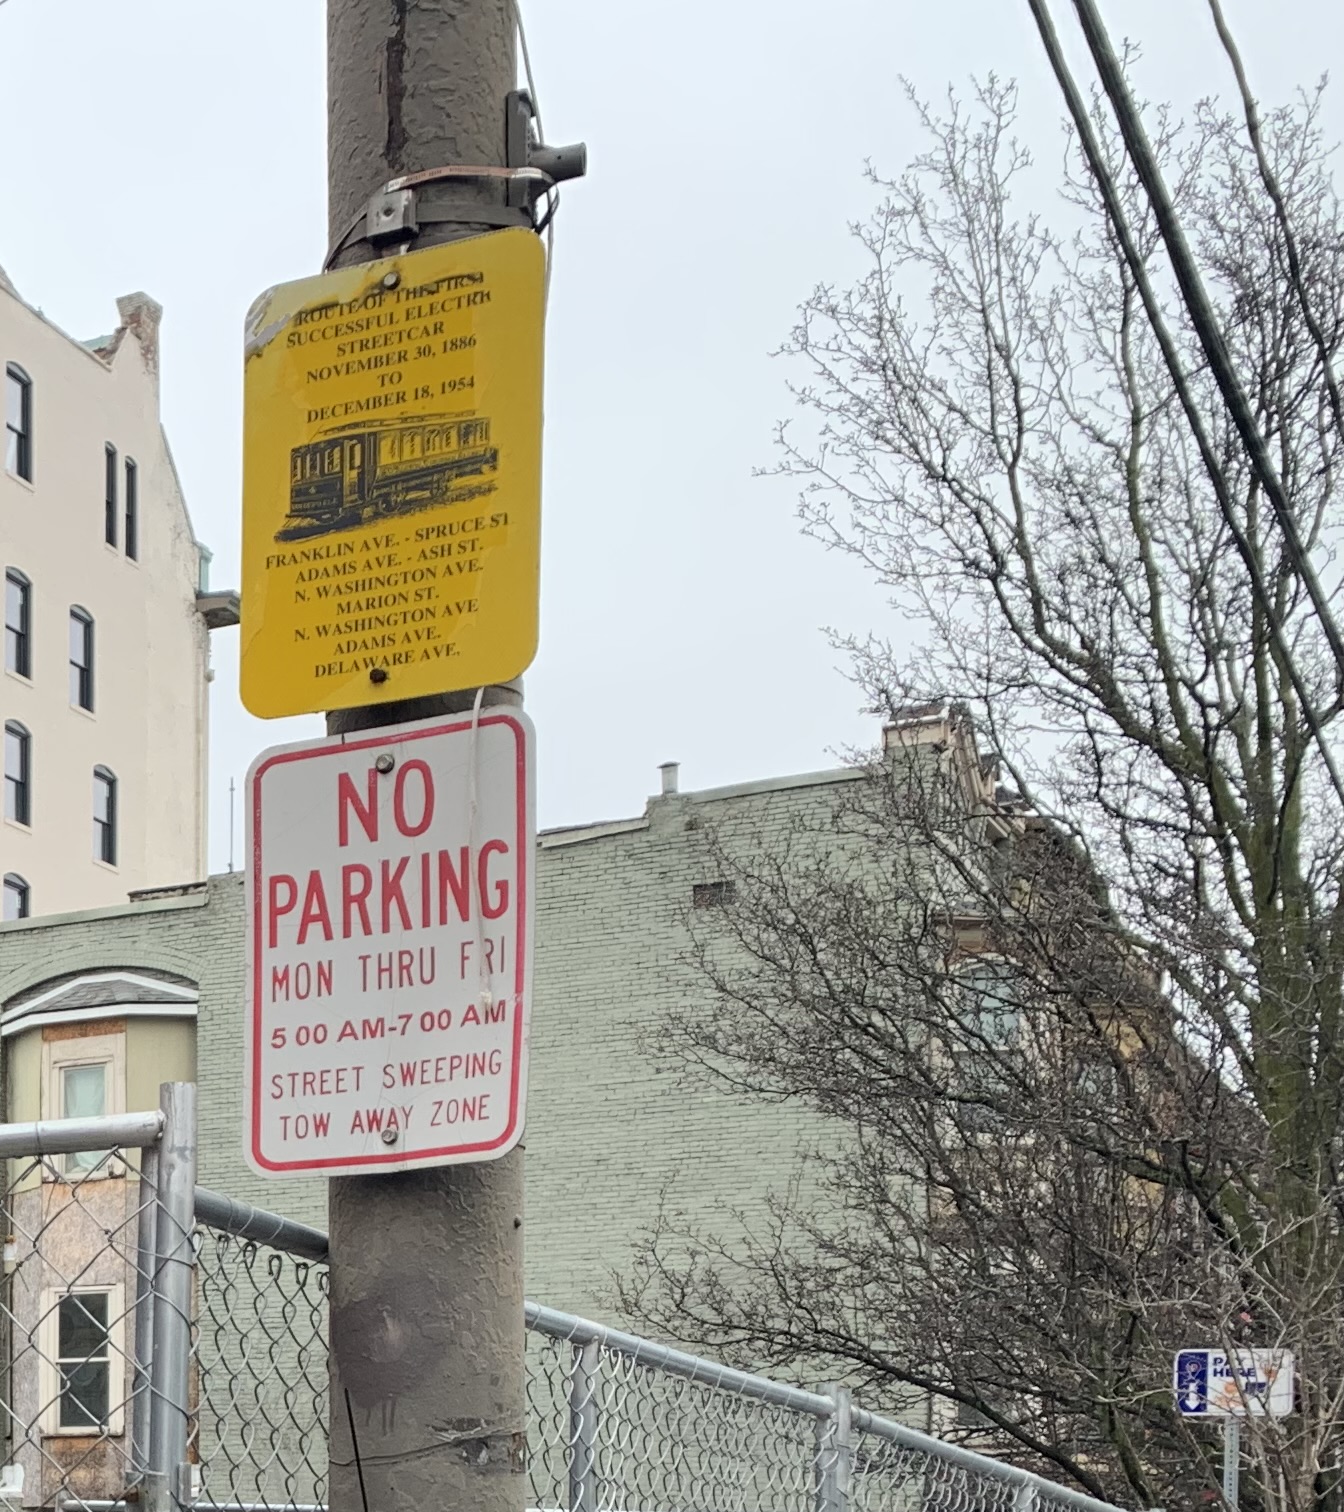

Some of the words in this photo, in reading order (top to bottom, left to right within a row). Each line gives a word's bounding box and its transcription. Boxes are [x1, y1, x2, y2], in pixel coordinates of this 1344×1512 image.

[364, 289, 388, 310] OF
[286, 310, 401, 349] SUCCESSFUL
[336, 319, 445, 357] STREETCAR
[306, 346, 409, 383] NOVEMBER
[413, 343, 436, 360] 30,
[443, 332, 477, 353] 1886
[377, 370, 403, 388] TO
[306, 389, 407, 424] DECEMBER
[412, 385, 434, 402] 18,
[441, 375, 475, 396] 1954
[265, 541, 355, 570] FRANKLIN
[359, 533, 400, 553] AVE.
[414, 516, 486, 543] SPRUCE
[295, 560, 357, 584] ADAMS
[362, 553, 402, 573] AVE.
[417, 542, 453, 562] ASH
[457, 537, 484, 555] ST.
[294, 588, 310, 604] N.
[315, 566, 438, 600] WASHINGTON
[442, 558, 484, 578] AVE.
[336, 591, 410, 616] MARION
[413, 586, 440, 603] ST.
[294, 627, 310, 642] N.
[315, 605, 437, 638] WASHINGTON
[333, 633, 396, 657] ADAMS
[401, 626, 441, 646] AVE.
[314, 648, 415, 678] DELAWARE
[338, 758, 436, 848] NO
[268, 838, 511, 950] PARKING
[271, 958, 334, 1003] MON
[358, 945, 437, 993] THRU
[460, 934, 506, 981] FRI
[460, 999, 506, 1027] AM
[271, 1065, 365, 1101] STREET
[382, 1048, 503, 1091] SWEEPING
[279, 1110, 331, 1142] TOW
[350, 1104, 414, 1136] AWAY
[430, 1094, 492, 1128] ZONE
